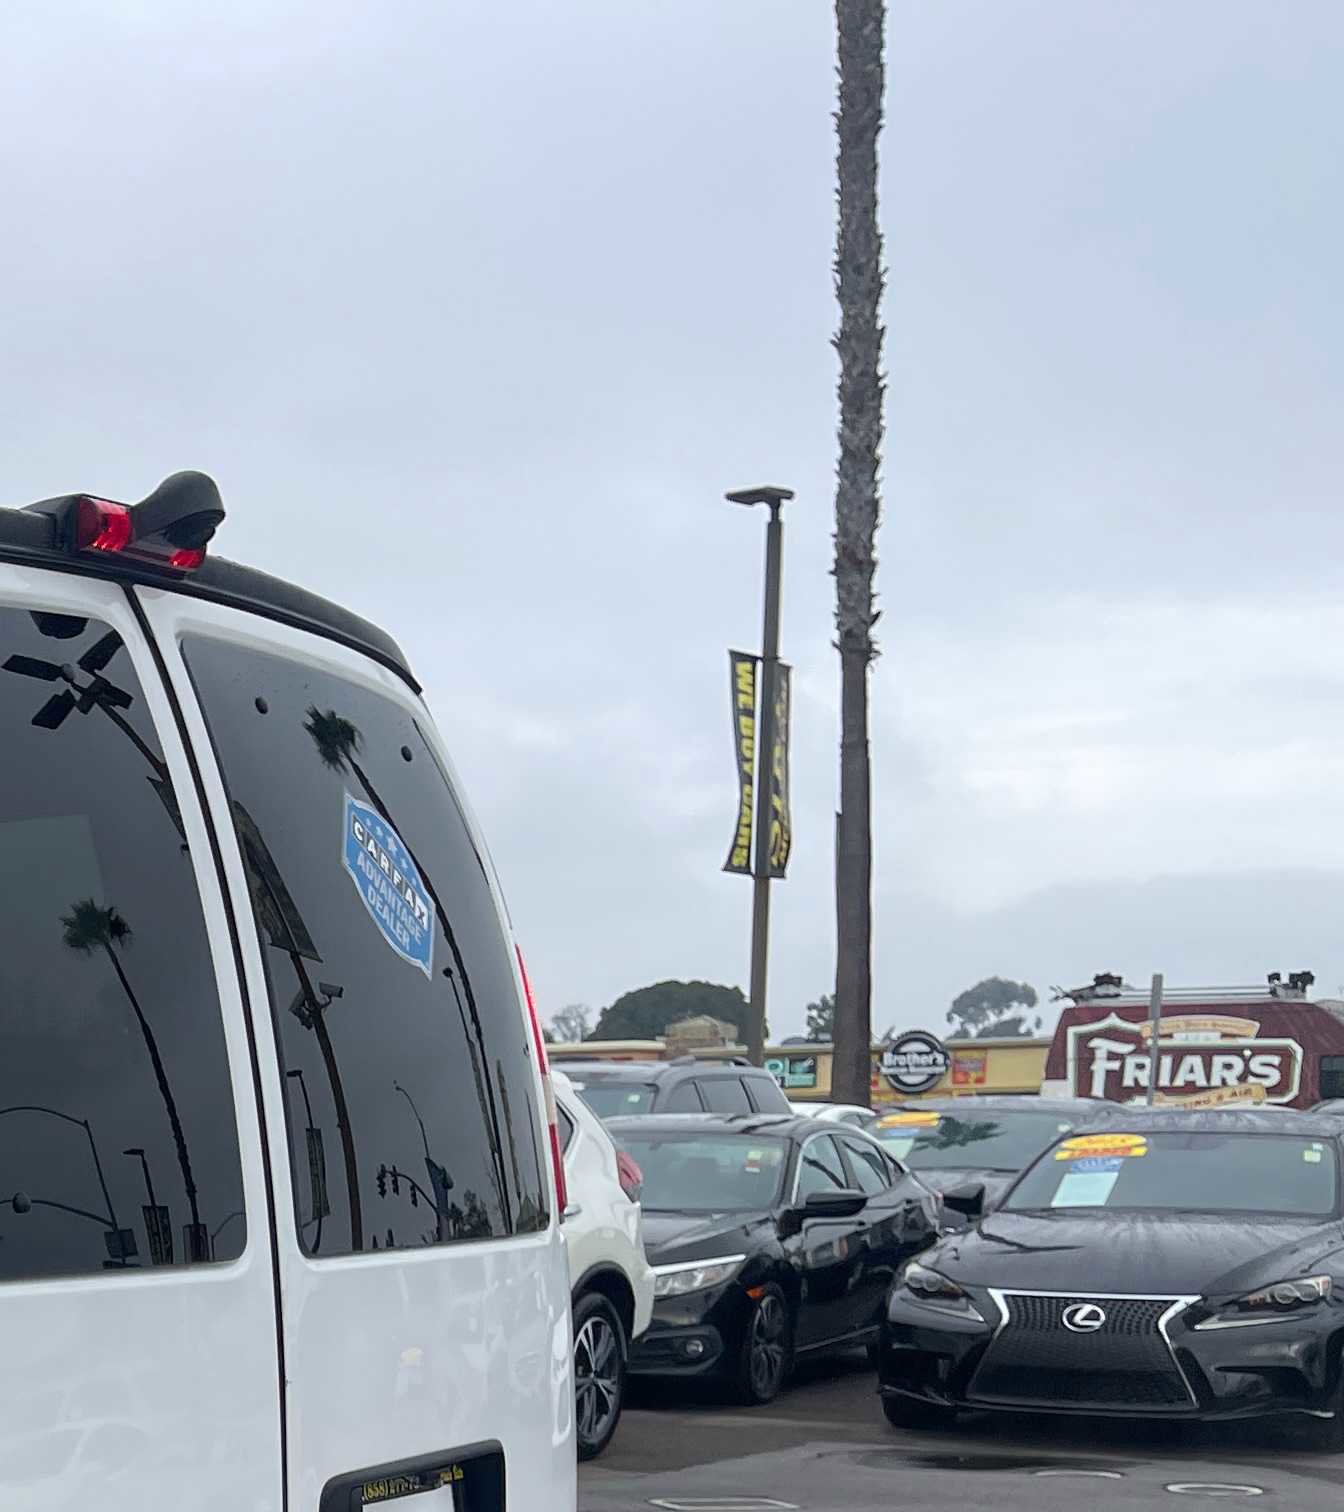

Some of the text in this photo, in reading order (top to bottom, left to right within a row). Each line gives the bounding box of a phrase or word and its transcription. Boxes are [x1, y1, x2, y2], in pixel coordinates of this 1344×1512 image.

[353, 822, 426, 921] CARFAX
[367, 885, 411, 951] DEALER
[1087, 1038, 1282, 1098] FRIAR'S
